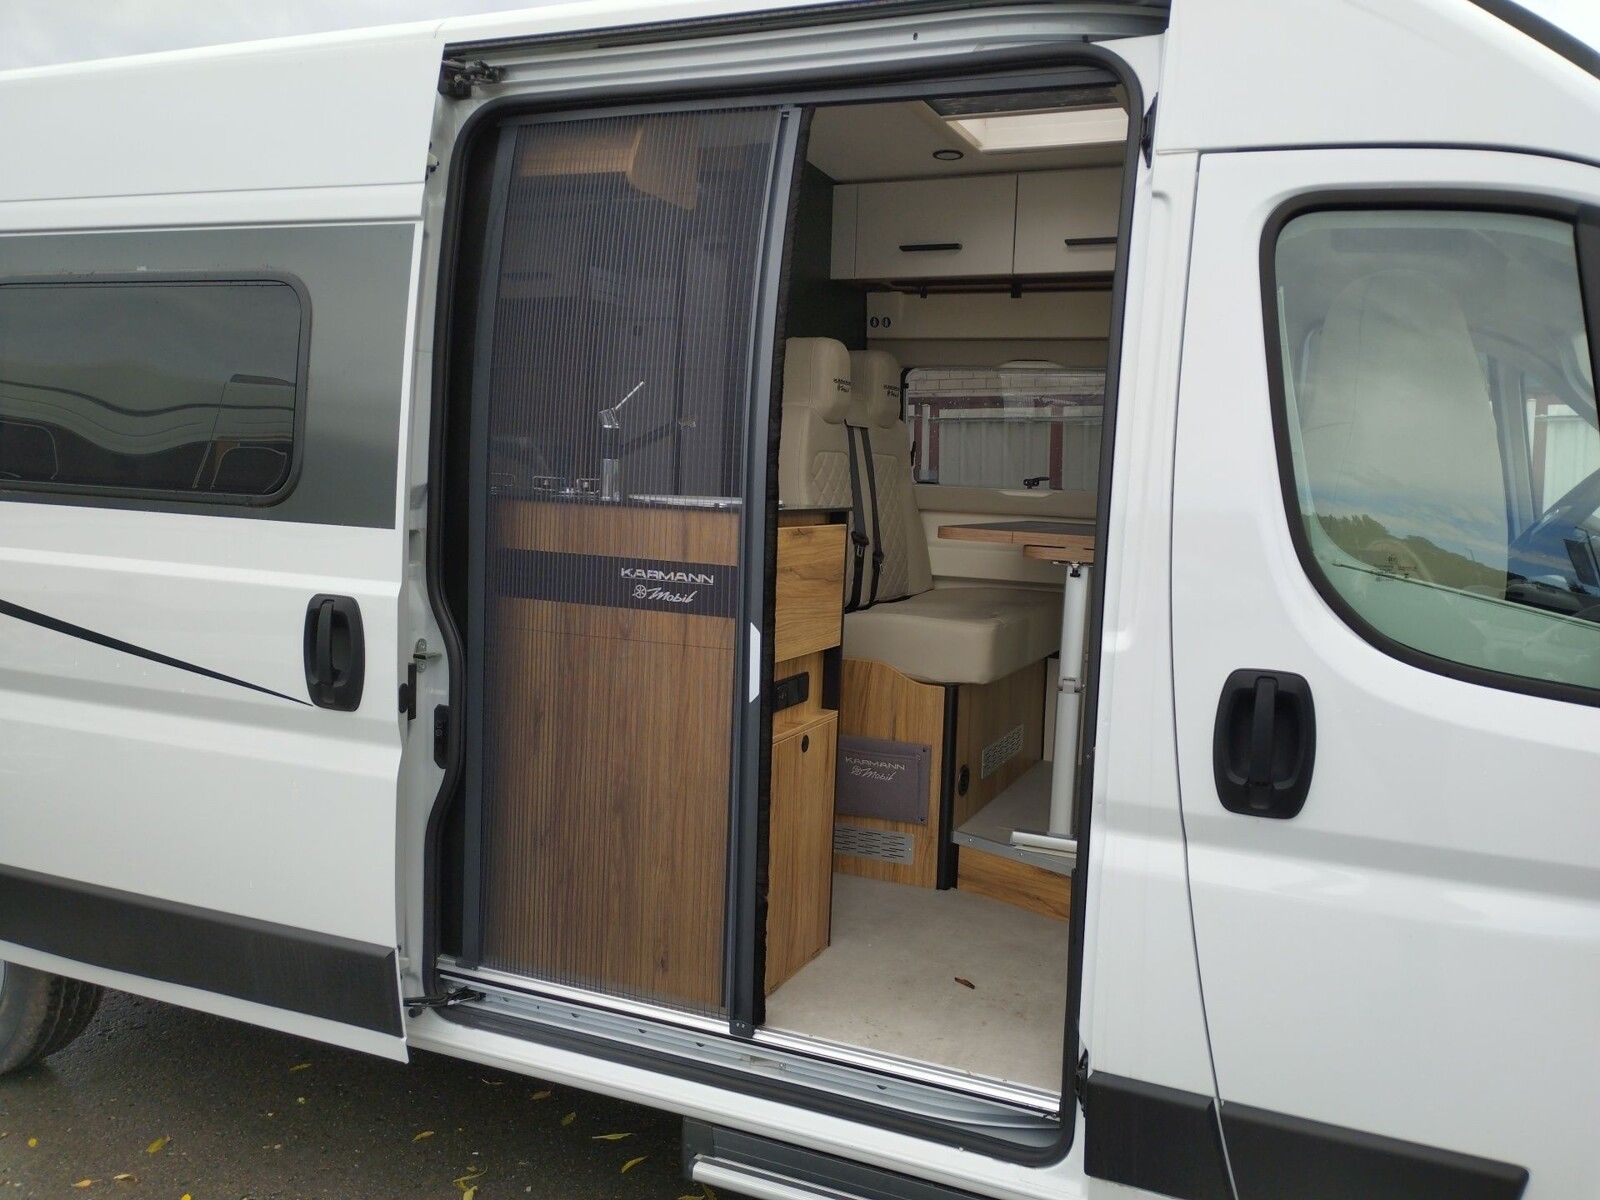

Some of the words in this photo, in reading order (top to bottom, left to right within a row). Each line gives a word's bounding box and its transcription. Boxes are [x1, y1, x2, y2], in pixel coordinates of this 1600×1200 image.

[620, 567, 715, 586] KARMANN
[646, 587, 698, 603] Mobil
[845, 756, 905, 771] KARMANN
